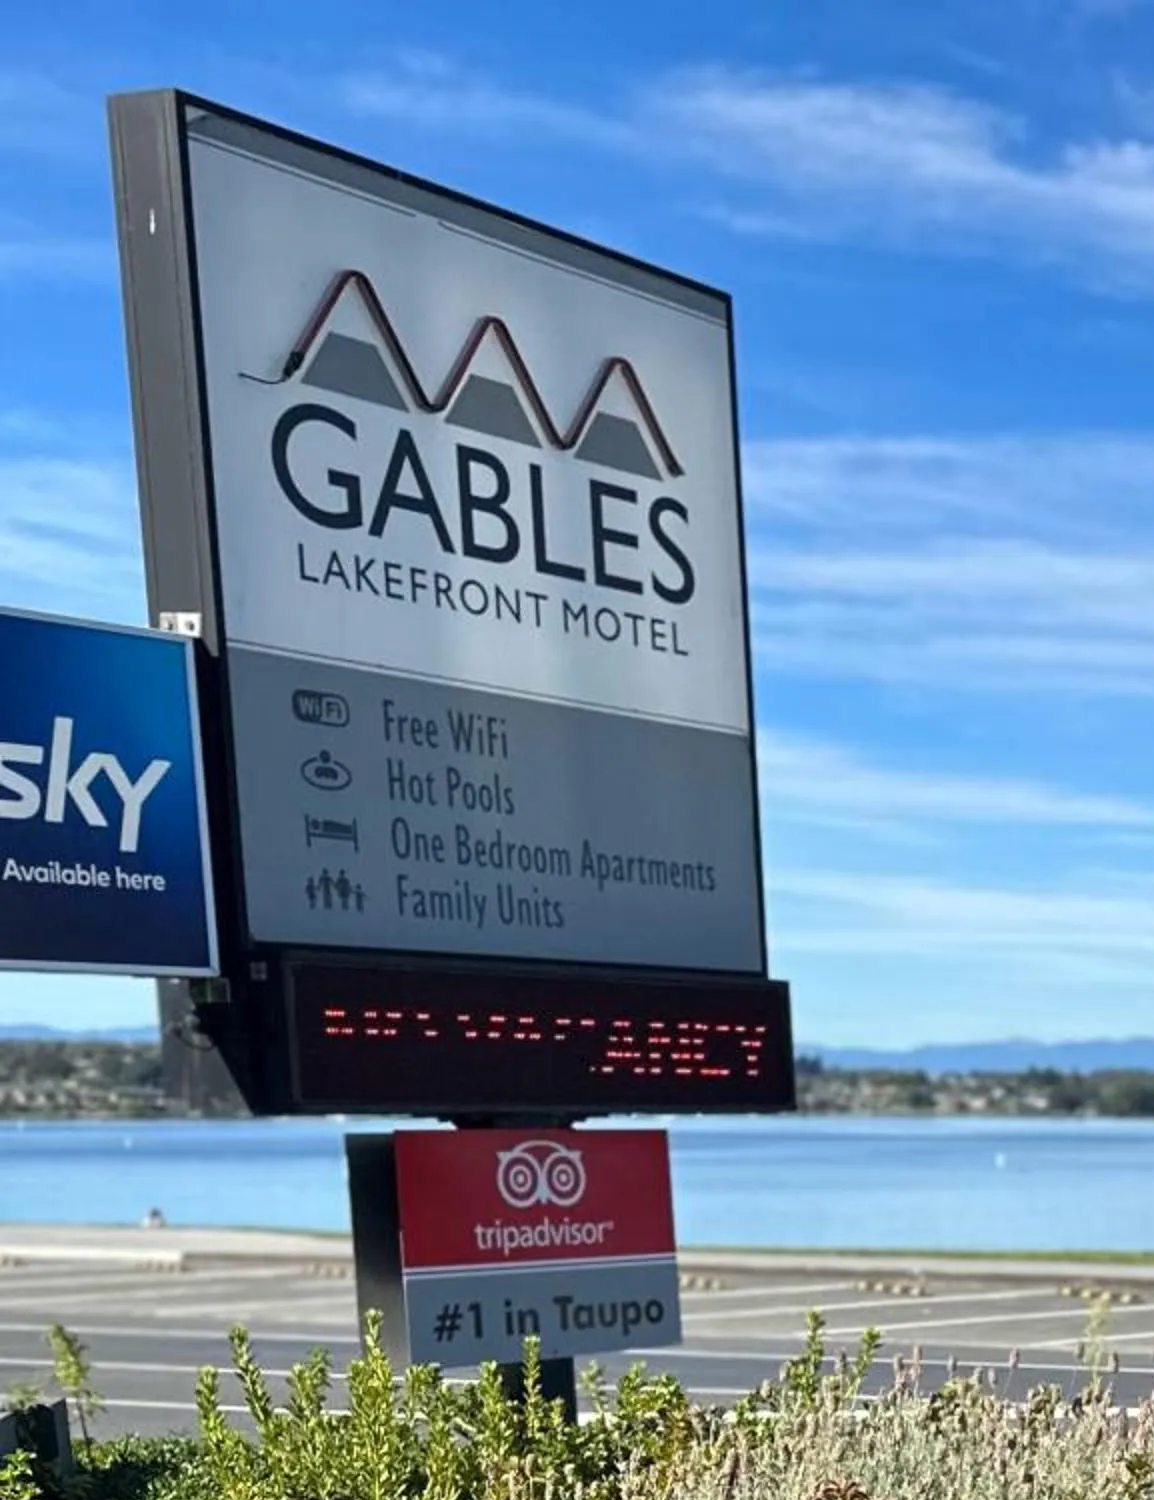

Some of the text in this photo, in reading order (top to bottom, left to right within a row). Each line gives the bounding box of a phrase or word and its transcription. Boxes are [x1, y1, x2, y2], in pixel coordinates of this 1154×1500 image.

[271, 402, 696, 605] GABLES
[297, 542, 689, 656] LAKEFRONT MOTEL
[382, 699, 508, 759] Free WiFi
[0, 716, 172, 852] sky
[387, 758, 515, 815] Hot Pools
[2, 858, 166, 891] Available here
[391, 817, 717, 892] One Bedroom Apartments
[396, 874, 565, 929] Family Units
[474, 1217, 607, 1256] tripadvisor
[433, 1296, 665, 1342] #1 in Taupo
